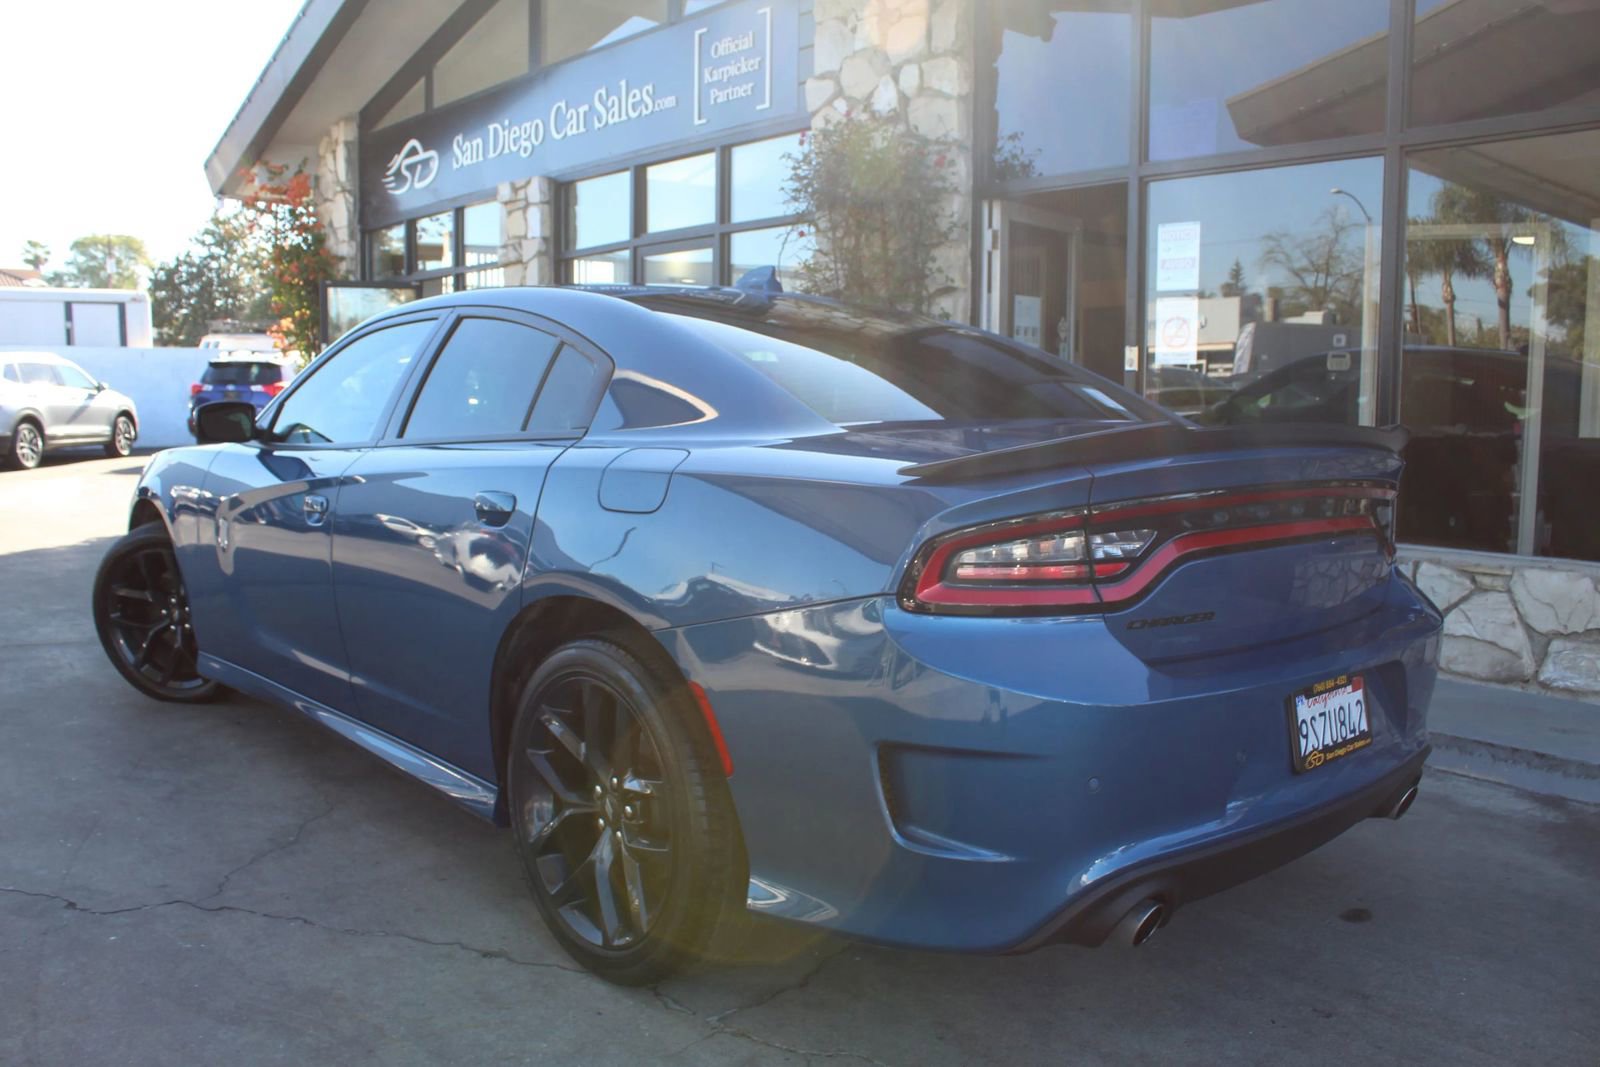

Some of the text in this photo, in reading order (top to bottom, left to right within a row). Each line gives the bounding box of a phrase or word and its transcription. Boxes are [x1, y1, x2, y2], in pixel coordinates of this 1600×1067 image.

[711, 30, 754, 58] Official
[703, 56, 761, 84] Karpicker
[709, 82, 754, 105] Partner
[452, 133, 484, 170] San
[487, 118, 544, 158] Diego
[550, 99, 590, 141] Car
[1126, 610, 1216, 631] CHARGER
